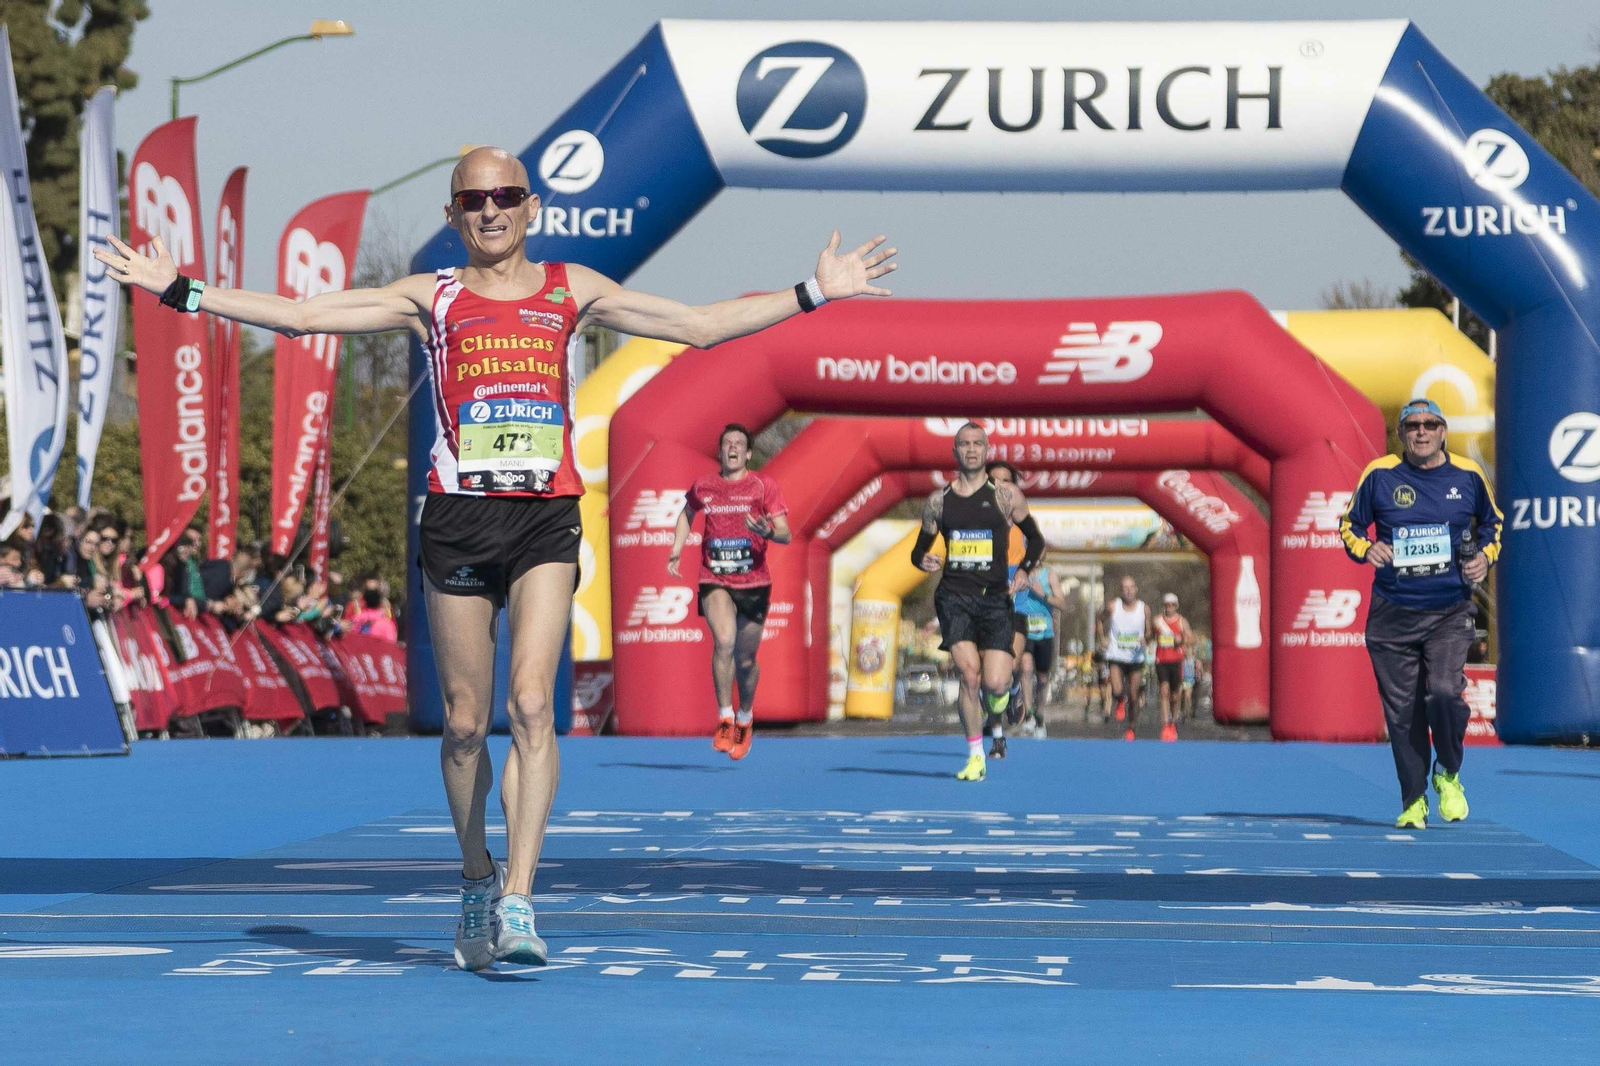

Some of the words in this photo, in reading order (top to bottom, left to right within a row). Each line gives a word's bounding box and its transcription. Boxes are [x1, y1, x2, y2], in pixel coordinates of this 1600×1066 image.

[913, 65, 1284, 132] ZURICH
[526, 206, 634, 237] RICH
[1421, 203, 1567, 237] ZURICH
[461, 333, 554, 354] Clínicas
[457, 356, 561, 382] Polisalud
[817, 356, 882, 381] new
[886, 354, 1018, 385] balance
[473, 381, 541, 399] Continental
[494, 404, 553, 420] ZURICH
[173, 343, 208, 502] balance
[711, 504, 751, 514] Santander
[1512, 496, 1600, 531] ZURI
[617, 534, 641, 548] new
[642, 530, 703, 547] balace
[1409, 526, 1443, 537] ZURICH
[961, 545, 977, 554] 371
[1283, 534, 1308, 549] new
[1403, 543, 1440, 556] 12335
[444, 579, 485, 587] POLISALUD
[618, 629, 641, 643] new
[643, 626, 704, 643] balance
[1282, 631, 1308, 646] new
